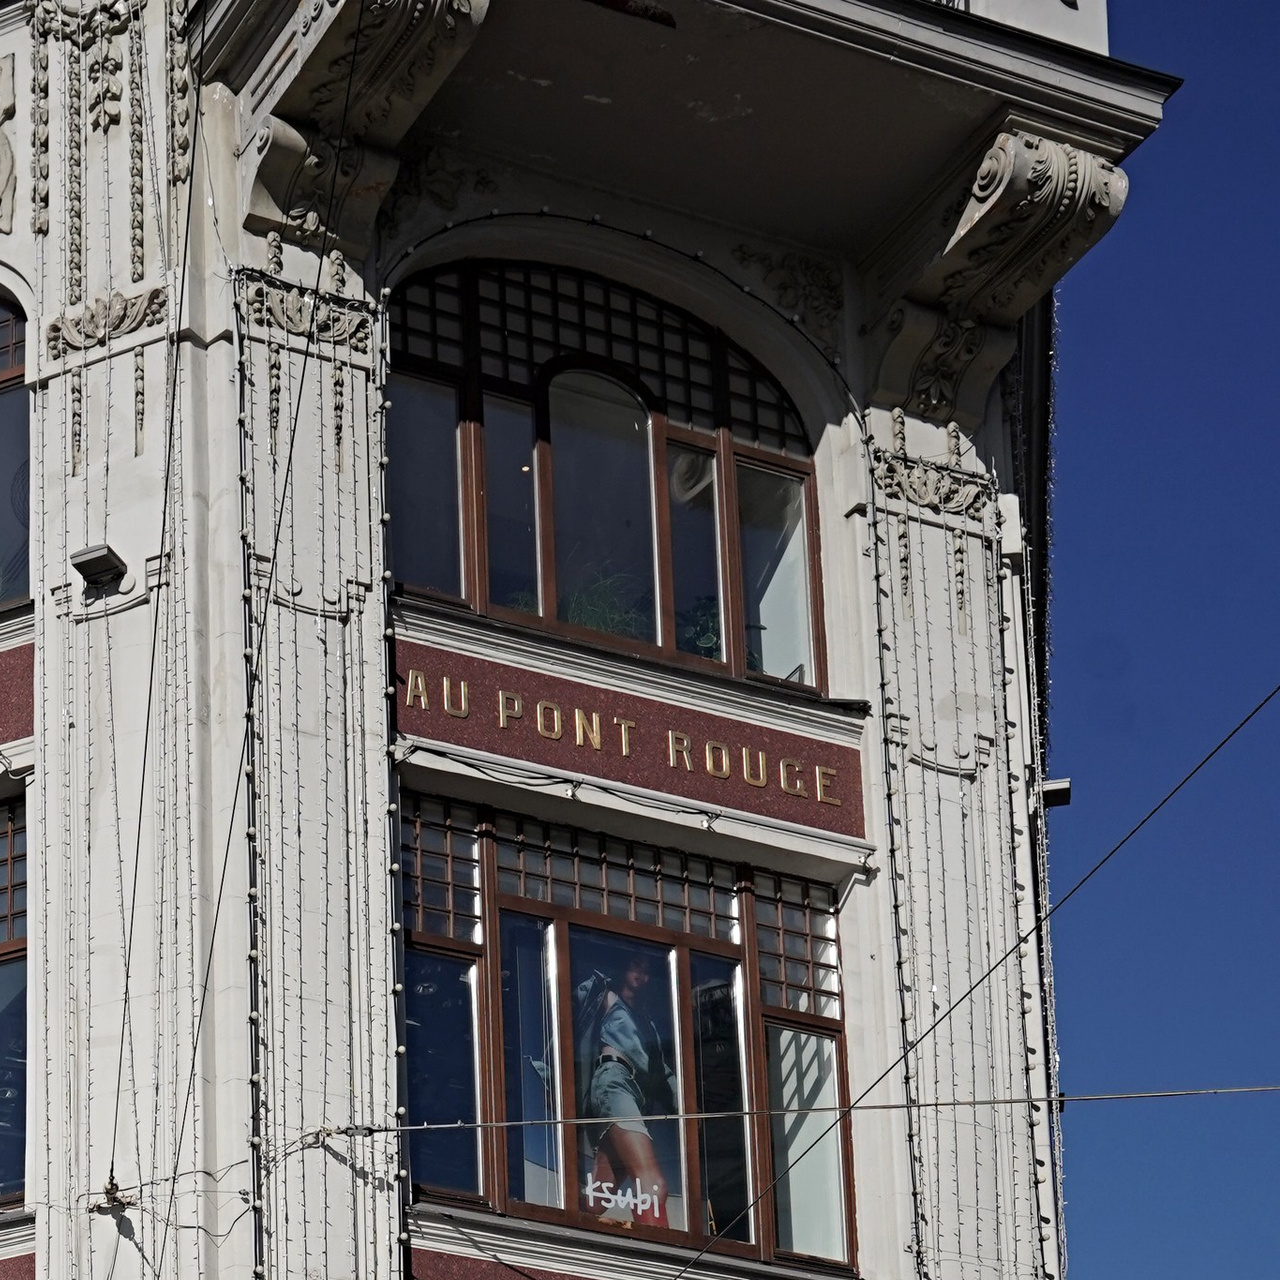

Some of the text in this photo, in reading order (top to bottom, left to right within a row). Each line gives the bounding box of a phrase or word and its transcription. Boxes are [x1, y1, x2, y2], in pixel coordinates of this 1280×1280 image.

[405, 669, 842, 806] AU PONT ROUGE
